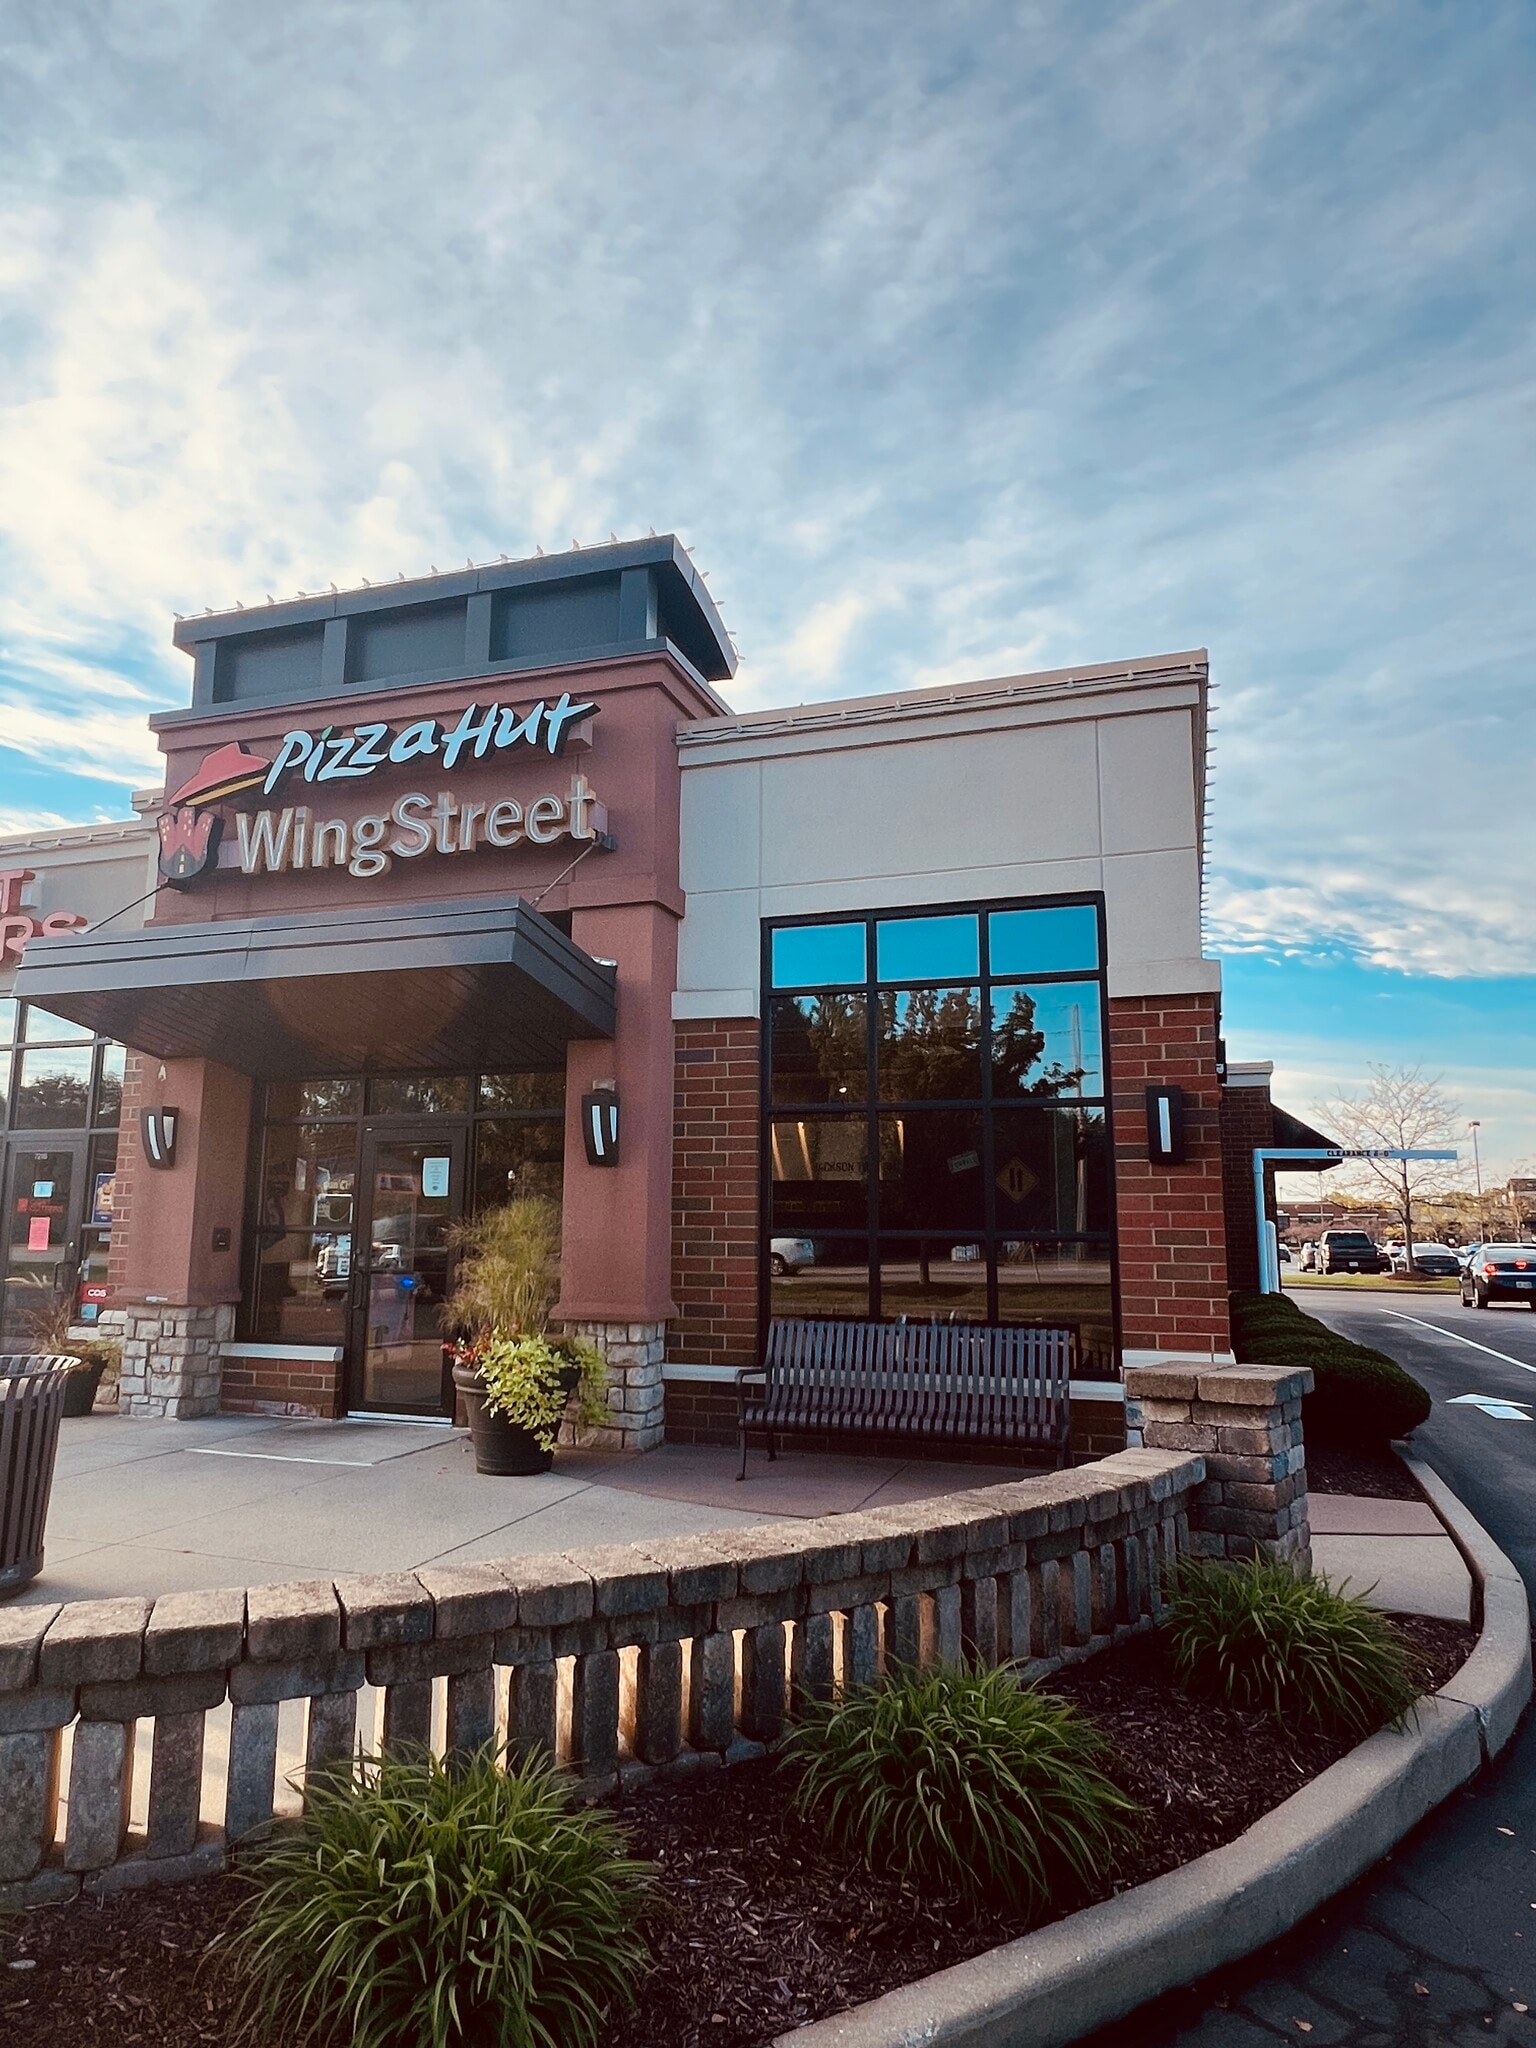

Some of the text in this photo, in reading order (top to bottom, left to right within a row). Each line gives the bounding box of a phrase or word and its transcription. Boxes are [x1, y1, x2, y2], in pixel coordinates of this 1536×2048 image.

[263, 691, 596, 795] Pizza Hut
[236, 774, 598, 878] WingStreet
